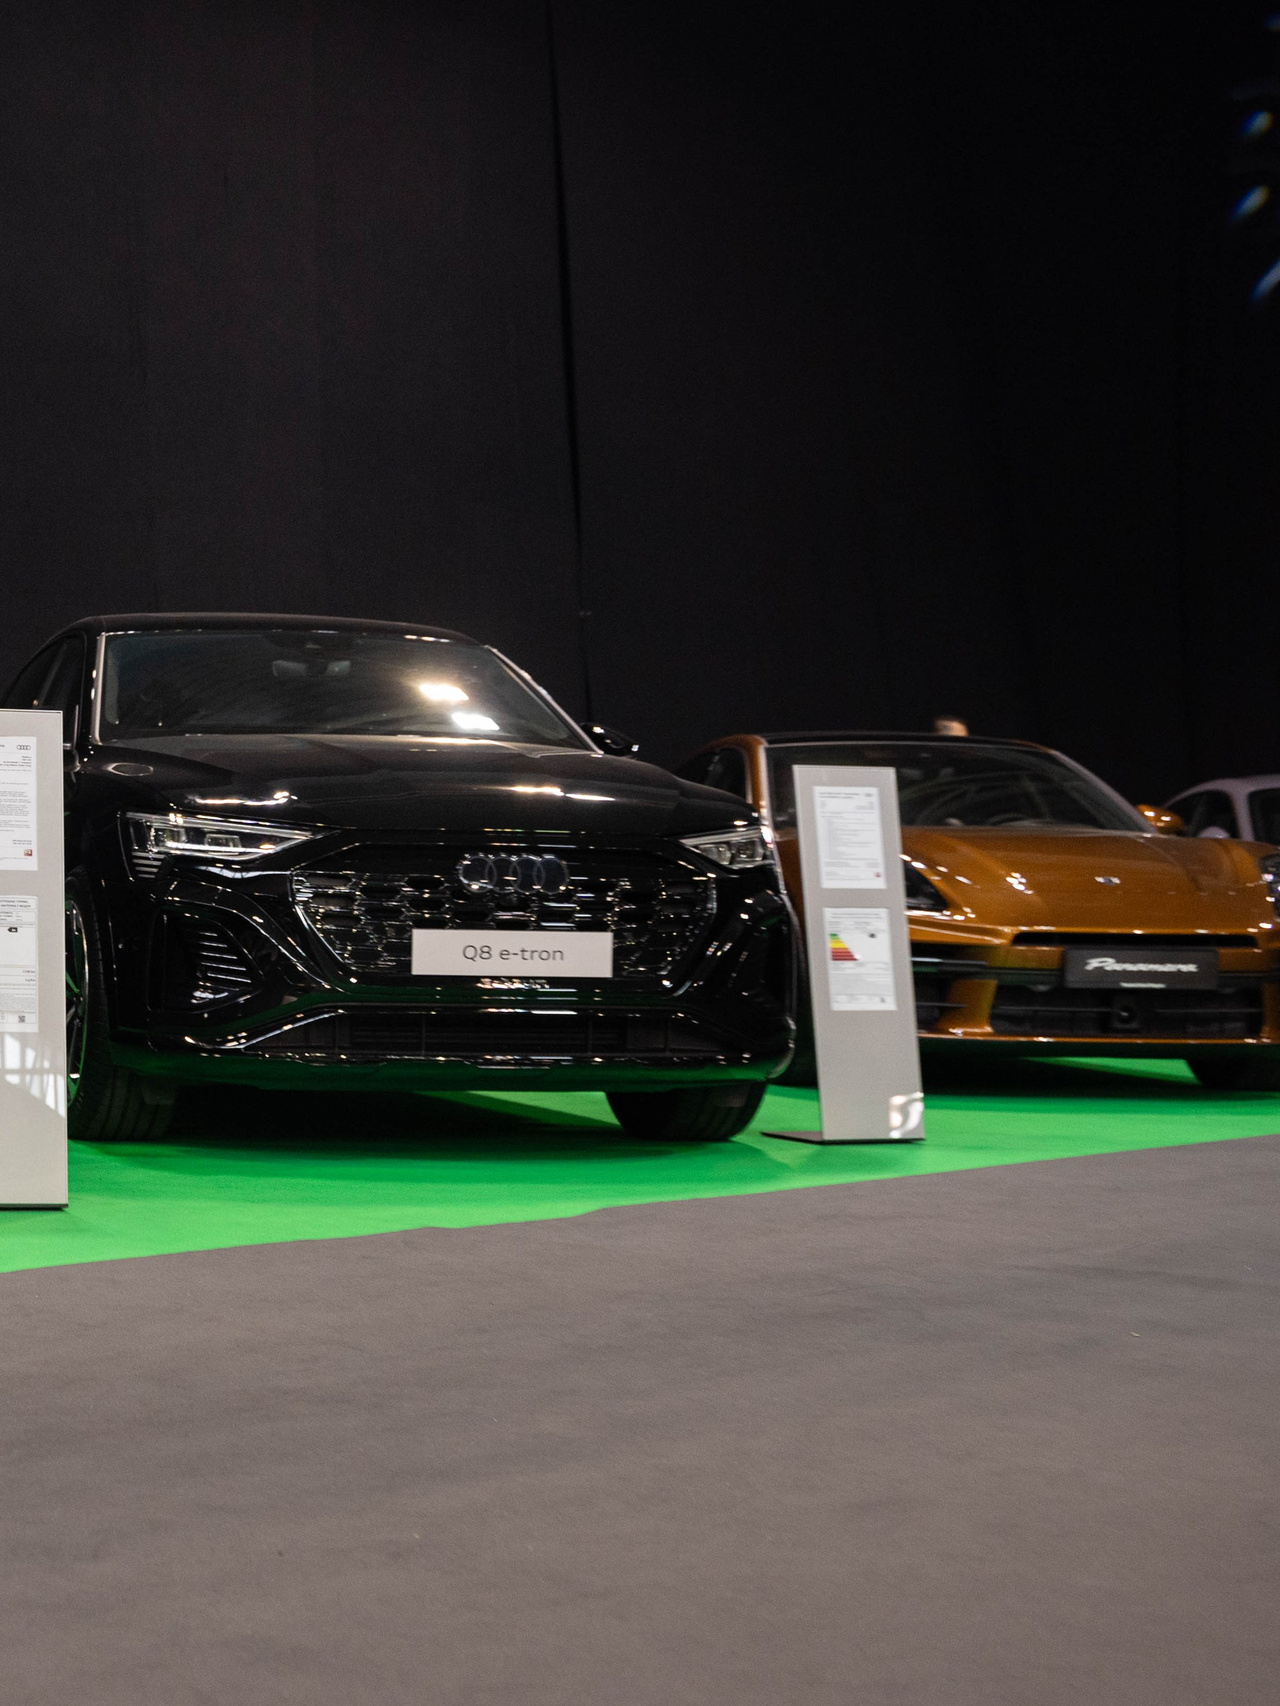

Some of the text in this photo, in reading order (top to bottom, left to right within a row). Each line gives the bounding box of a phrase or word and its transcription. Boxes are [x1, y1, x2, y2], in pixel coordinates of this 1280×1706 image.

[462, 944, 565, 962] Q8 e-tron
[1084, 957, 1199, 972] Panamera
